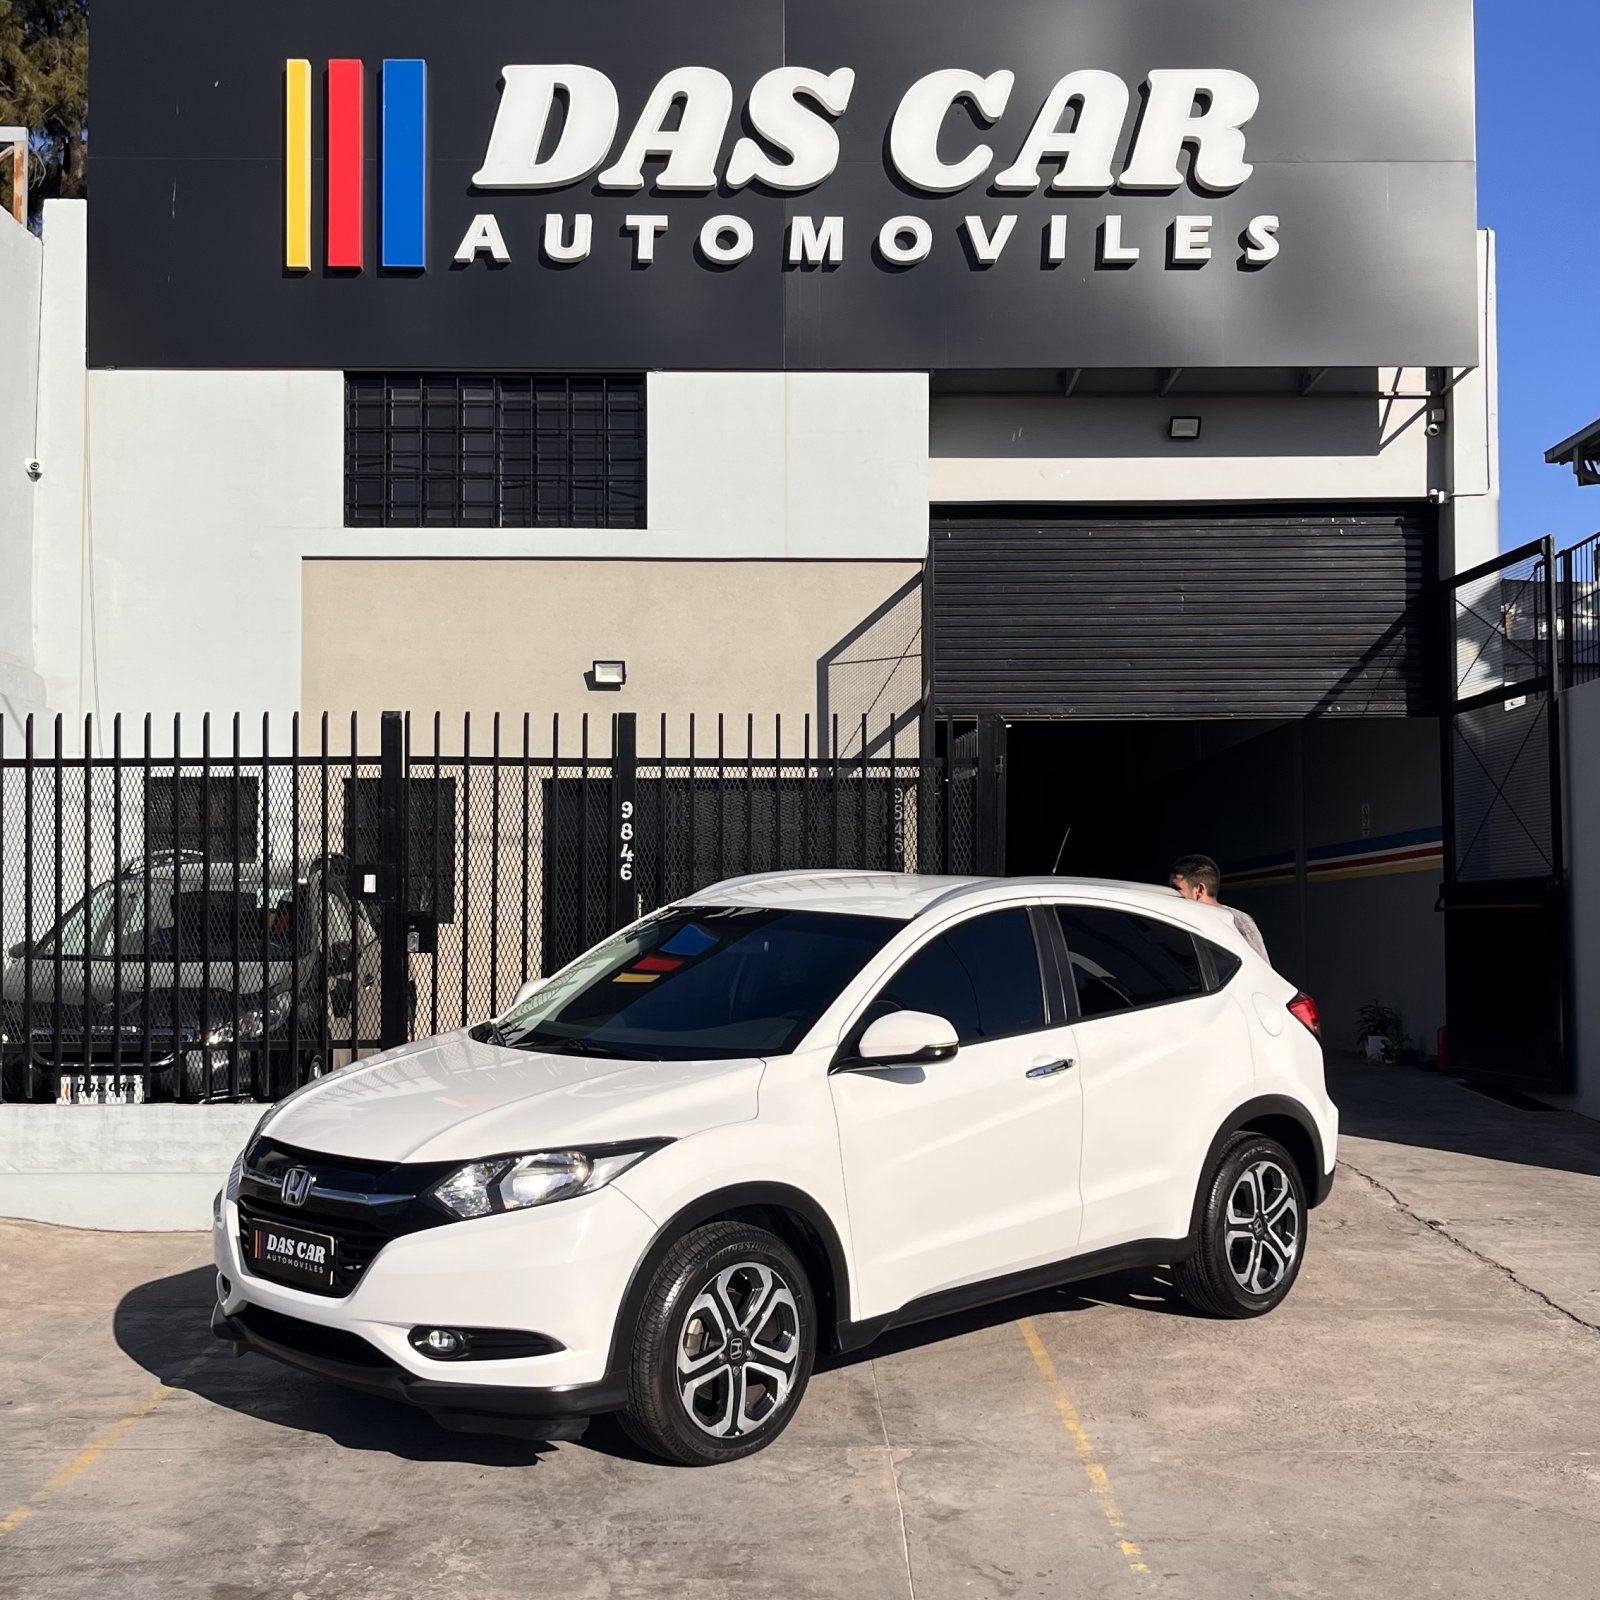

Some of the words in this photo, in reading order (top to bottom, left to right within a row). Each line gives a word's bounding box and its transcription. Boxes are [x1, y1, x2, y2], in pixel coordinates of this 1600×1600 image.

[471, 63, 856, 191] DAS
[889, 68, 1260, 192] CAR
[453, 213, 1281, 265] AUTOMOVILES
[620, 801, 635, 881] 9846
[266, 1233, 295, 1256] DAS
[296, 1241, 326, 1264] CAR
[266, 1253, 324, 1274] AUTOMOVILES
